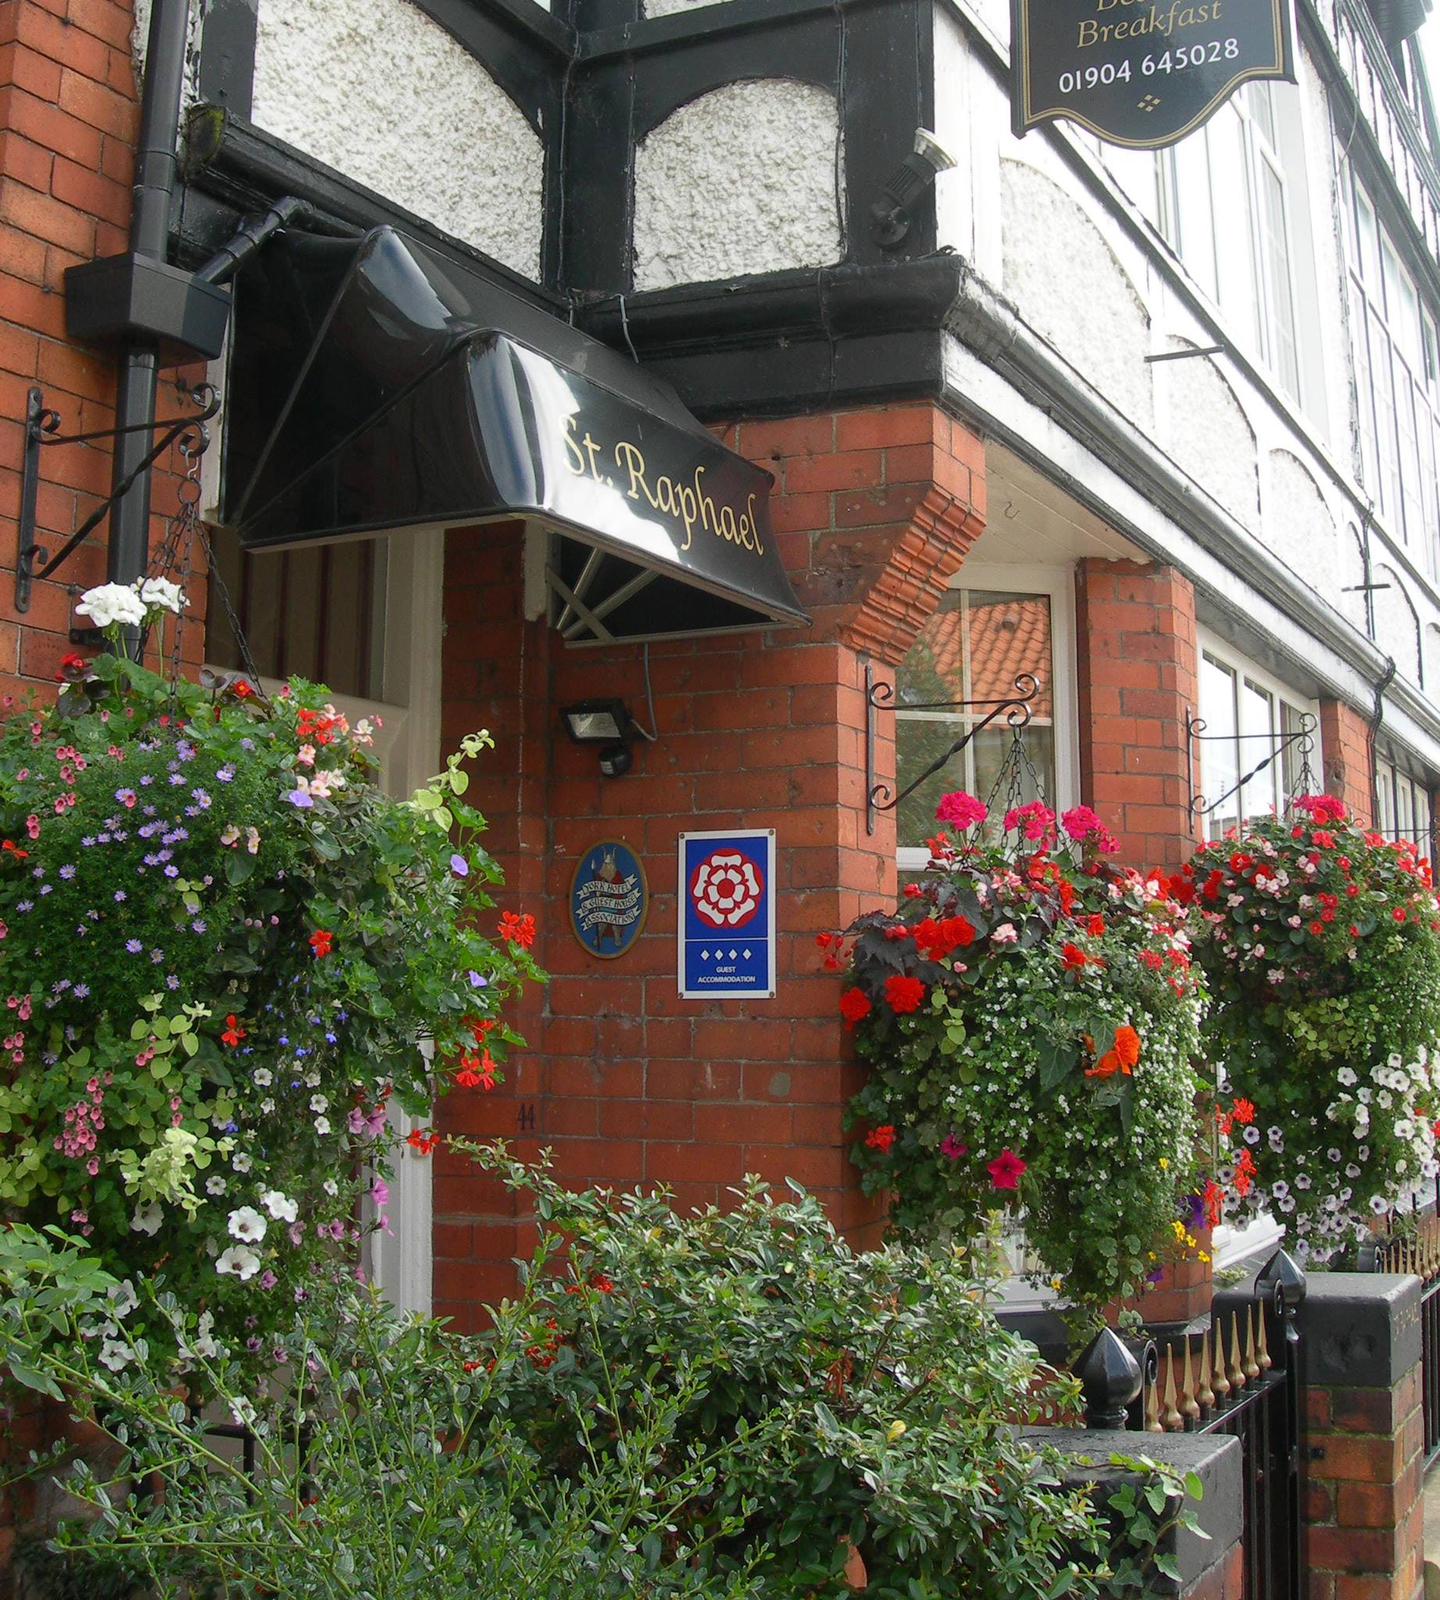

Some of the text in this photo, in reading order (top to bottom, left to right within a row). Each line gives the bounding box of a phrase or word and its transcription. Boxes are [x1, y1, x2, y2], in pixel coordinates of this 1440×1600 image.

[1077, 0, 1223, 48] Breakfast
[1059, 38, 1239, 93] 01904 645028
[560, 415, 764, 556] St. Raphael
[589, 898, 612, 908] GUEST
[613, 894, 637, 908] HOUSE
[607, 881, 631, 894] HOTEL
[585, 911, 635, 926] ASSOCIATION
